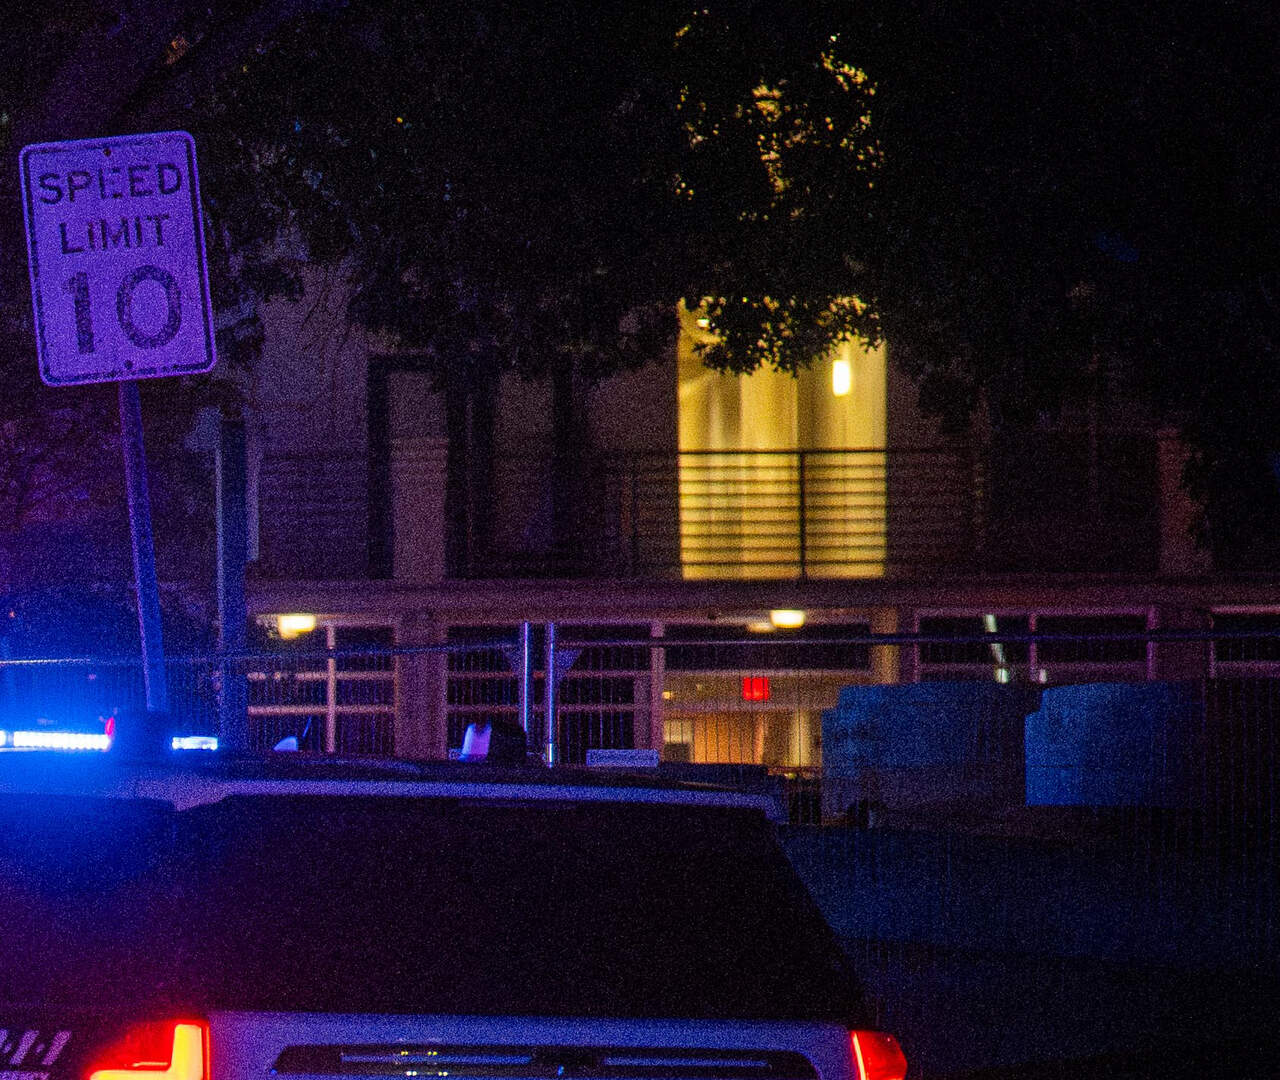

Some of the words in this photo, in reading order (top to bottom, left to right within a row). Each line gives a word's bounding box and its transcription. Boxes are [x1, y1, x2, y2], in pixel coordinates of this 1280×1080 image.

[40, 163, 181, 205] SPEED
[60, 214, 170, 254] LIMIT
[64, 265, 181, 352] 10
